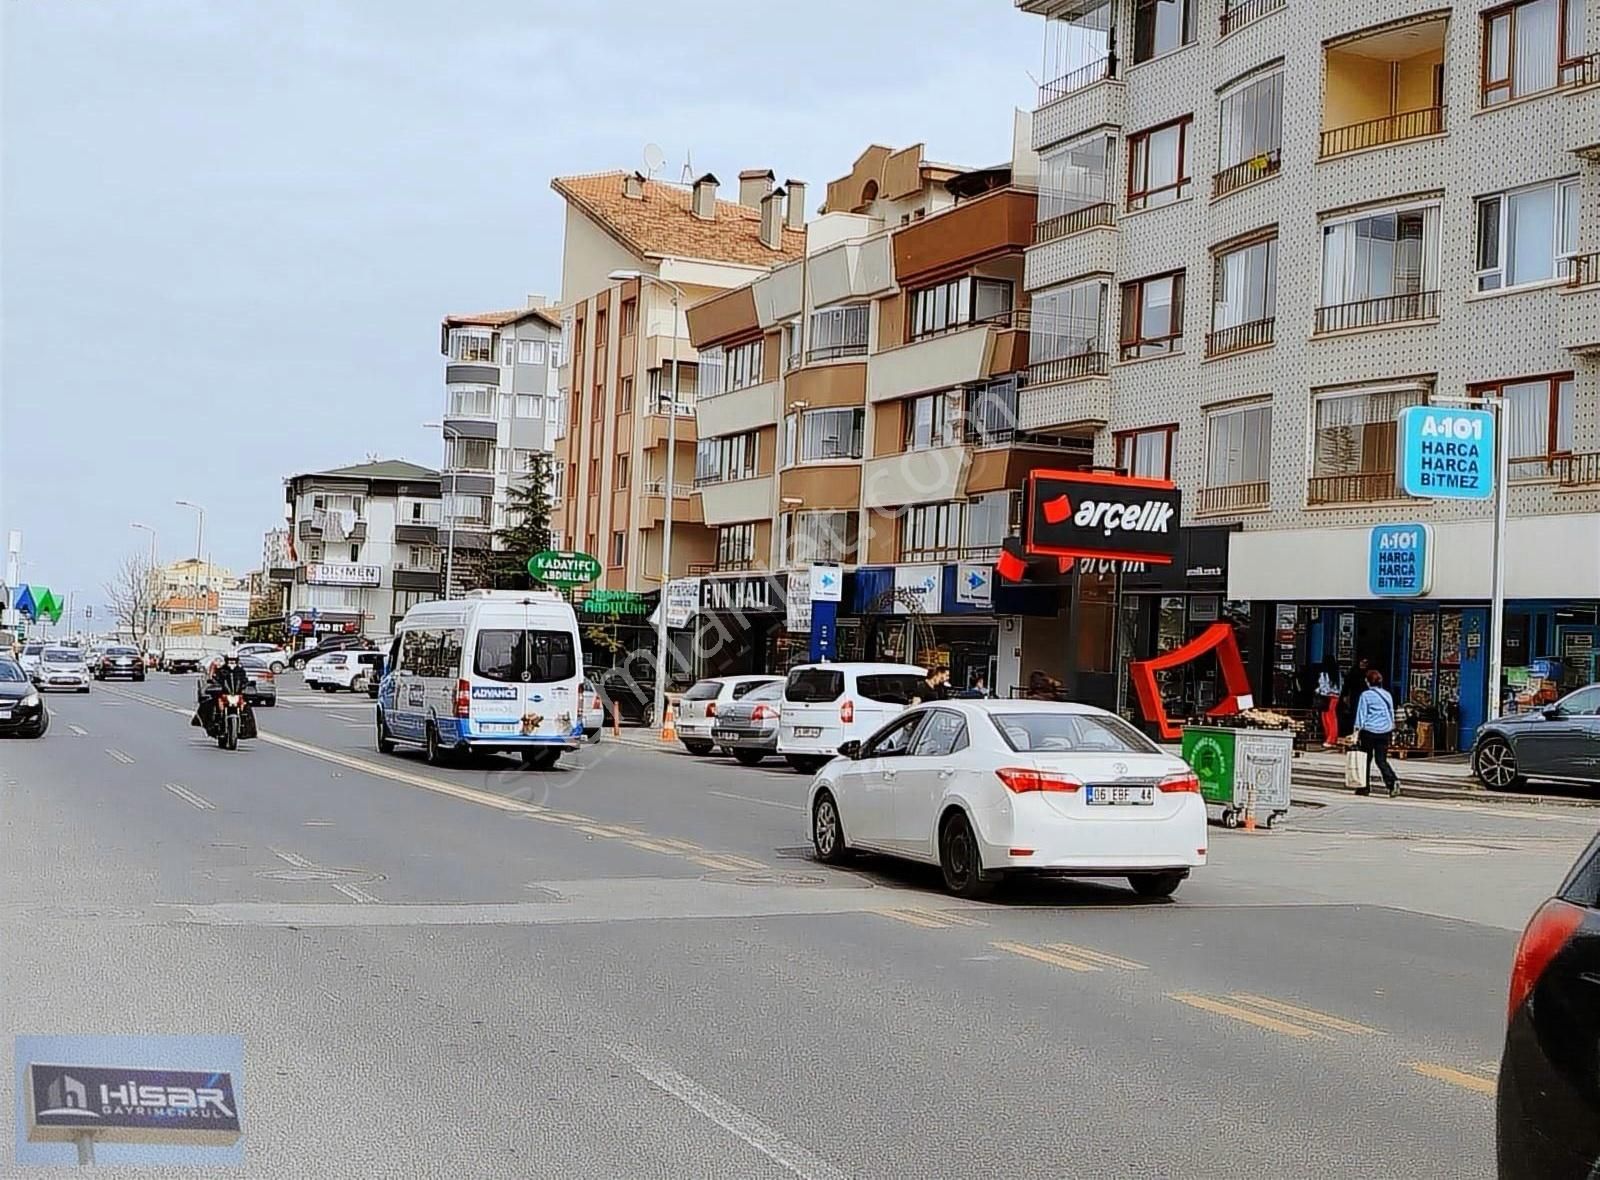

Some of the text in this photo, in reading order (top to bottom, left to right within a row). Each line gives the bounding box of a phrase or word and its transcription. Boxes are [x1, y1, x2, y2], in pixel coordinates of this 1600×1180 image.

[1421, 441, 1479, 458] HARCA
[1421, 457, 1479, 473] HARCA
[1074, 499, 1174, 536] arçelik
[1379, 551, 1415, 563] HARCA
[541, 570, 591, 582] ABDULLAH
[1379, 564, 1415, 576] HARCA
[735, 581, 770, 608] HALI
[584, 600, 647, 615] ABDULLAH
[1094, 788, 1152, 800] 06 EBF 44
